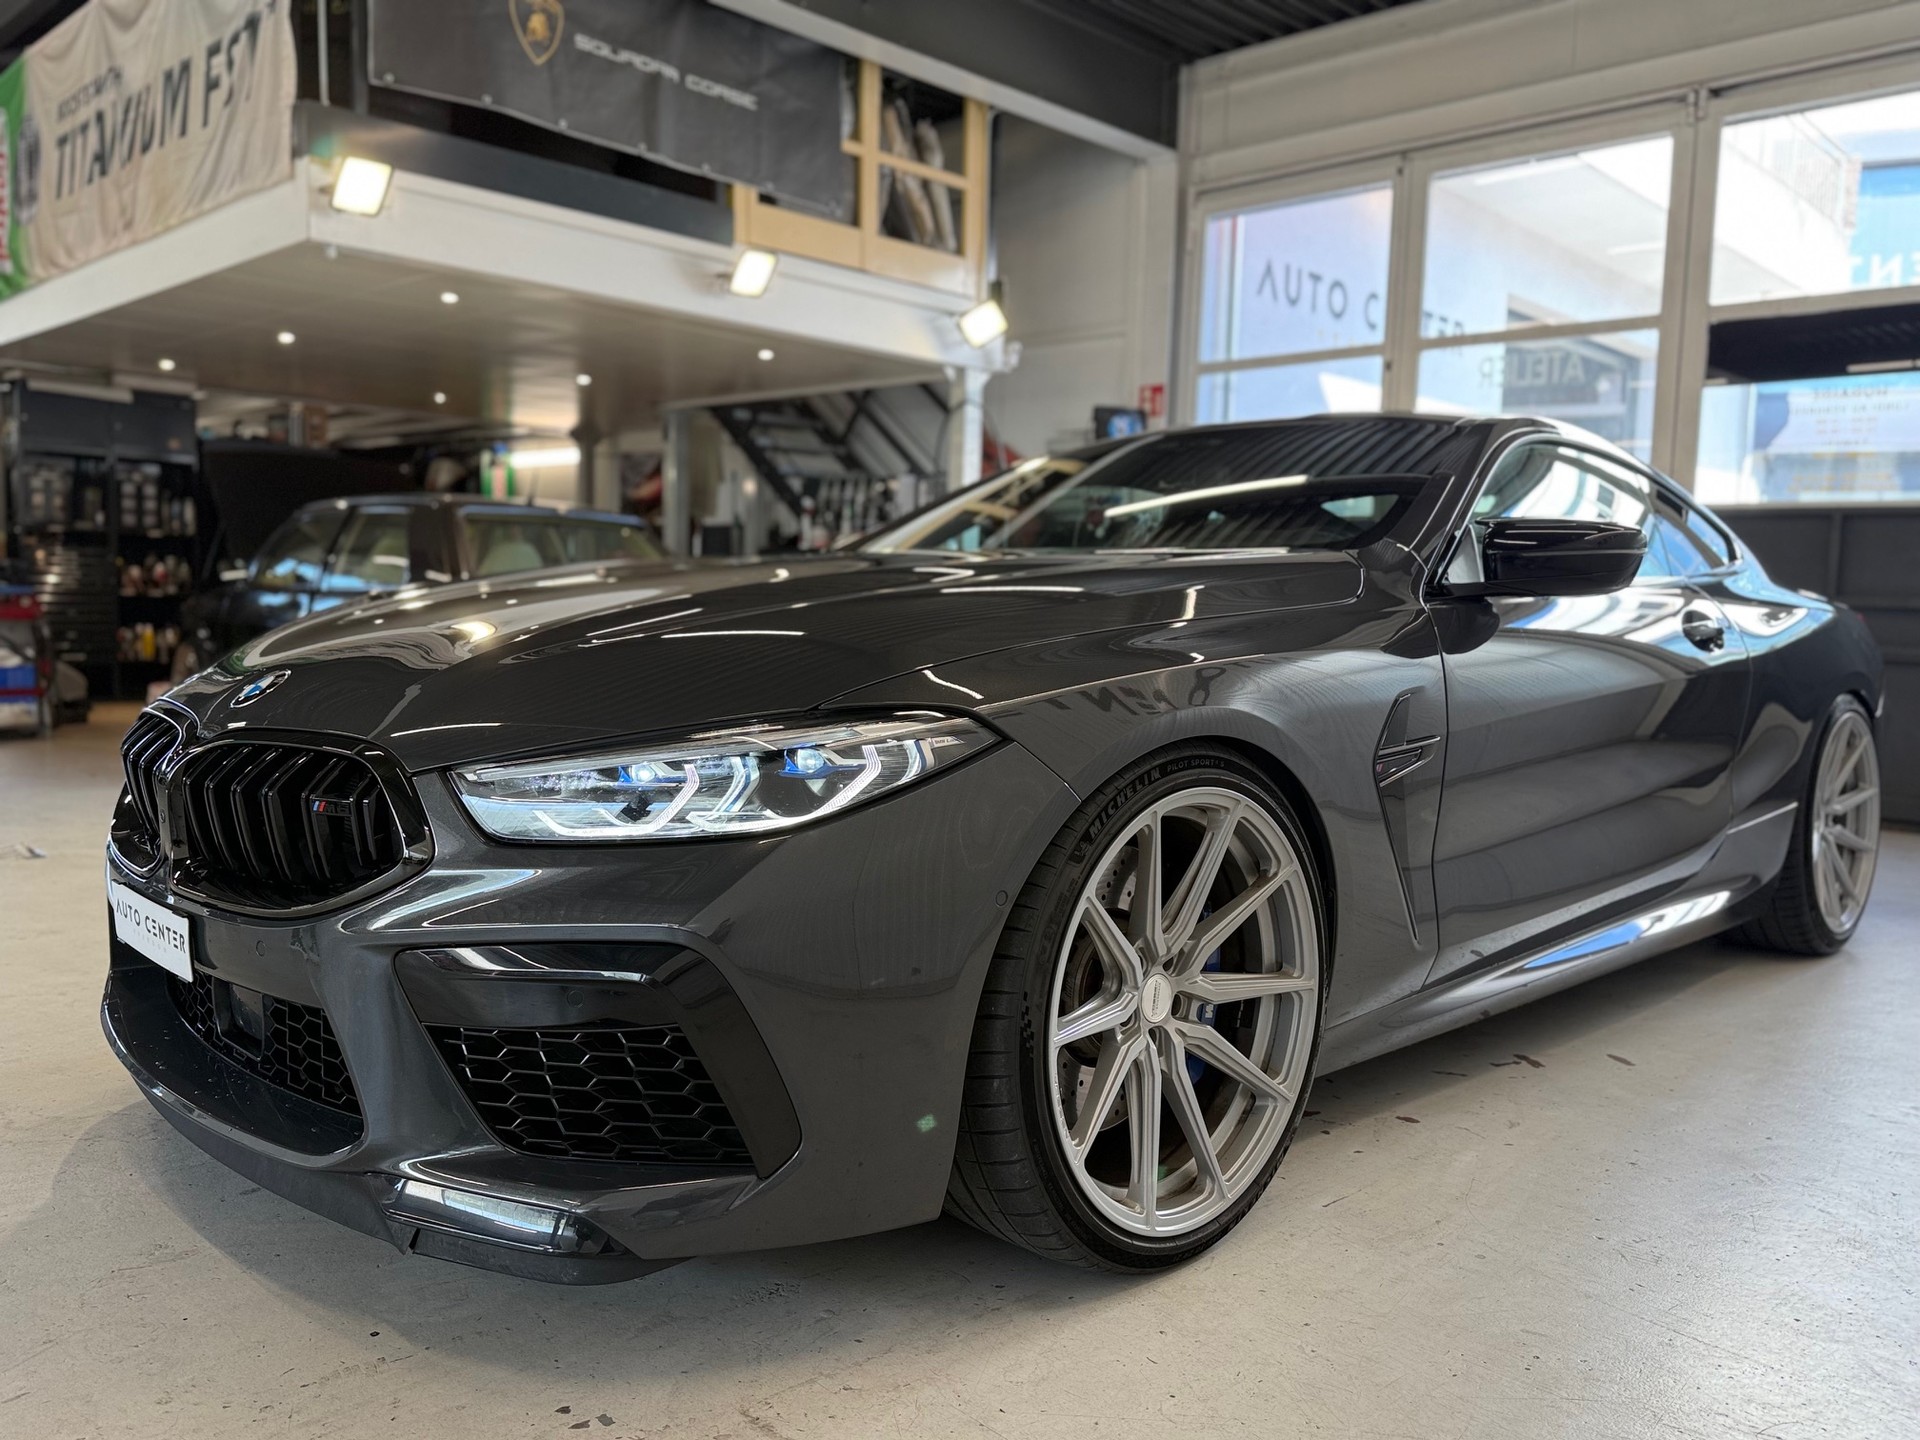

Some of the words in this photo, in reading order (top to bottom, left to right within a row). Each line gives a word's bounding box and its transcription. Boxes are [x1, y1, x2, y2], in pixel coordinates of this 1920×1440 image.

[1257, 258, 1348, 320] AUTO
[1089, 767, 1162, 839] MICHELIN
[1167, 759, 1189, 772] PILOT
[1190, 758, 1214, 767] SPORT
[116, 898, 141, 927] AUTO
[145, 915, 187, 954] CENTER
